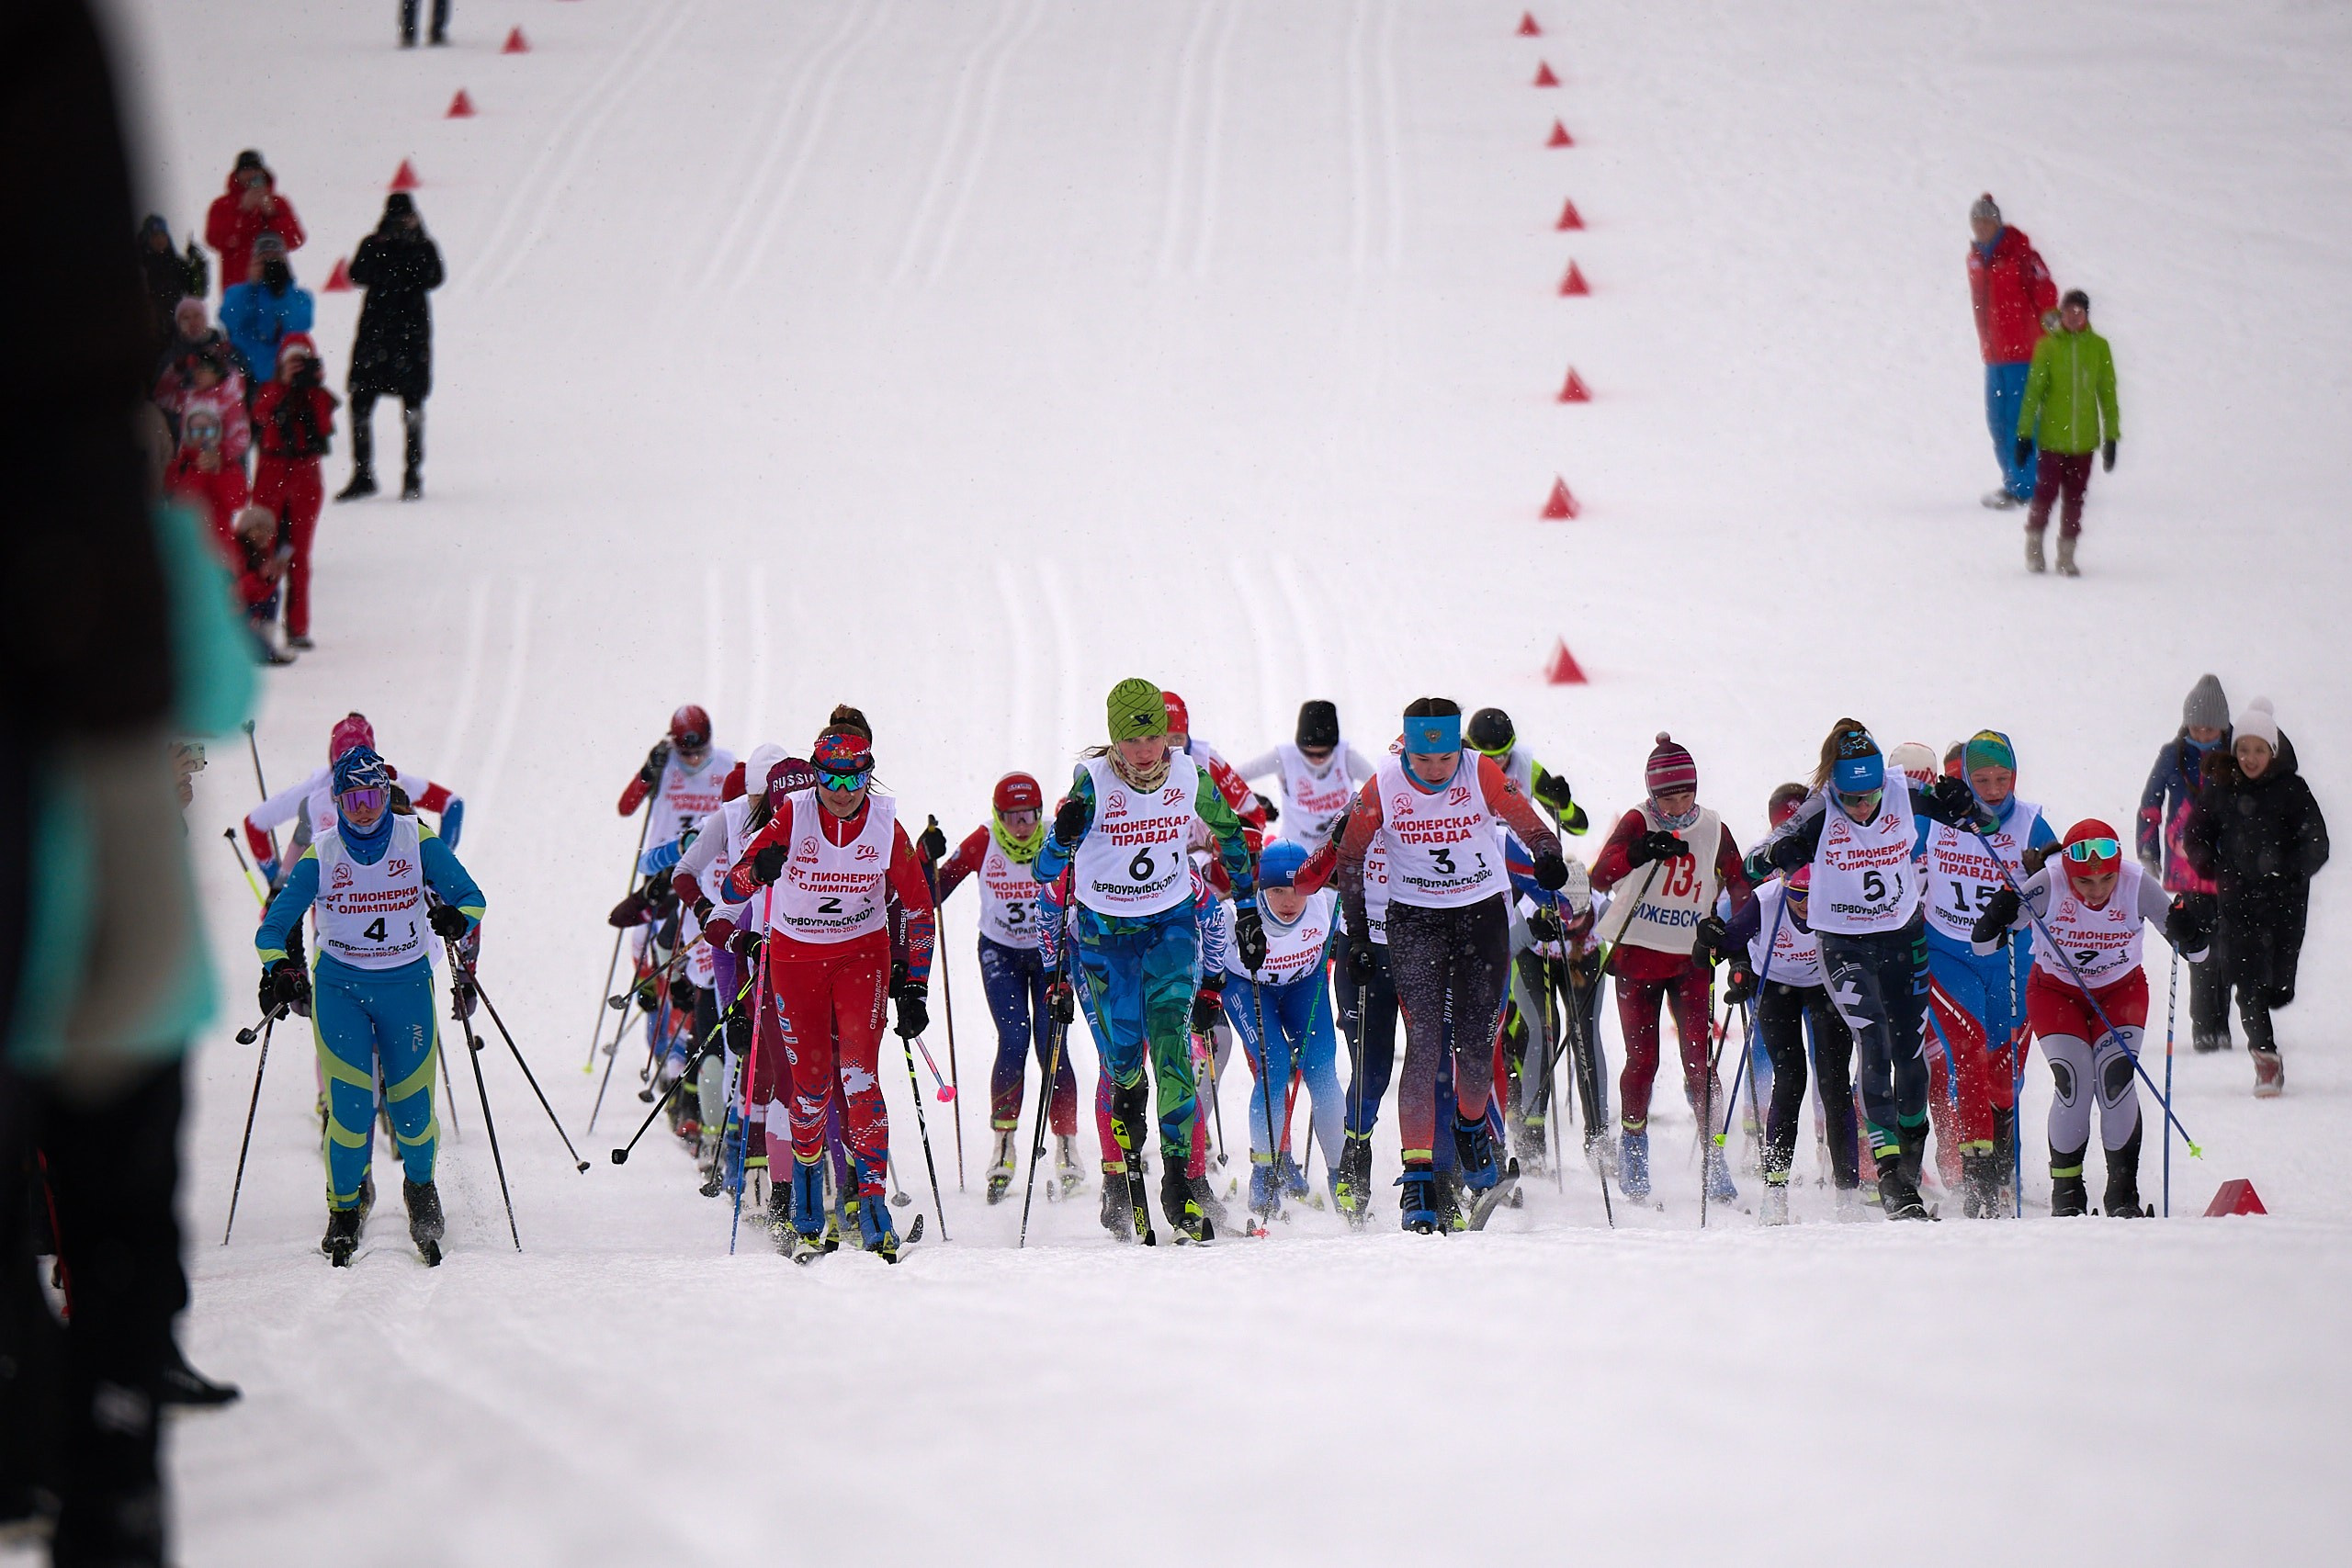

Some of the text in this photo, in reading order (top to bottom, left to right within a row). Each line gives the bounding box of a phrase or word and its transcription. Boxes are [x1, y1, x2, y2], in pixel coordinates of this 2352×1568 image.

[1163, 788, 1181, 799] 70
[1449, 787, 1466, 799] 70
[1104, 810, 1127, 819] КПРФ
[1101, 815, 1190, 833] ПИОНЕРСКАЯ
[1112, 829, 1179, 846] ПРАВДА
[1400, 829, 1472, 844] ПРАВДА
[1828, 837, 1851, 846] КПРФ
[1994, 832, 2011, 842] 70
[1826, 851, 1841, 860] ОТ
[1847, 839, 1906, 859] ПИОНЕРКИ
[1128, 846, 1155, 881] 6
[1368, 861, 1385, 871] ОТ
[1429, 848, 1456, 874] 3
[1933, 848, 2018, 869] ПИОНЕРСКАЯ
[790, 866, 883, 883] ОТ ПИОНЕРКИ
[1661, 852, 1696, 897] 13
[1939, 861, 2006, 882] ПРАВДА
[349, 886, 419, 902] ПИОНЕРКИ
[1863, 871, 1886, 902] 5
[818, 897, 843, 913] 2
[1950, 881, 1996, 912] 15
[1633, 902, 1702, 928] ИЖЕВСК
[363, 918, 389, 942] 4
[827, 925, 857, 933] 1950-2020
[2049, 925, 2136, 941] ОТ ПИОНЕРКИ
[2075, 950, 2099, 965] 9
[2118, 949, 2127, 958] 1
[869, 969, 882, 1030] СВЕРДЛОВСКАЯ
[1230, 993, 1259, 1044] SPINE
